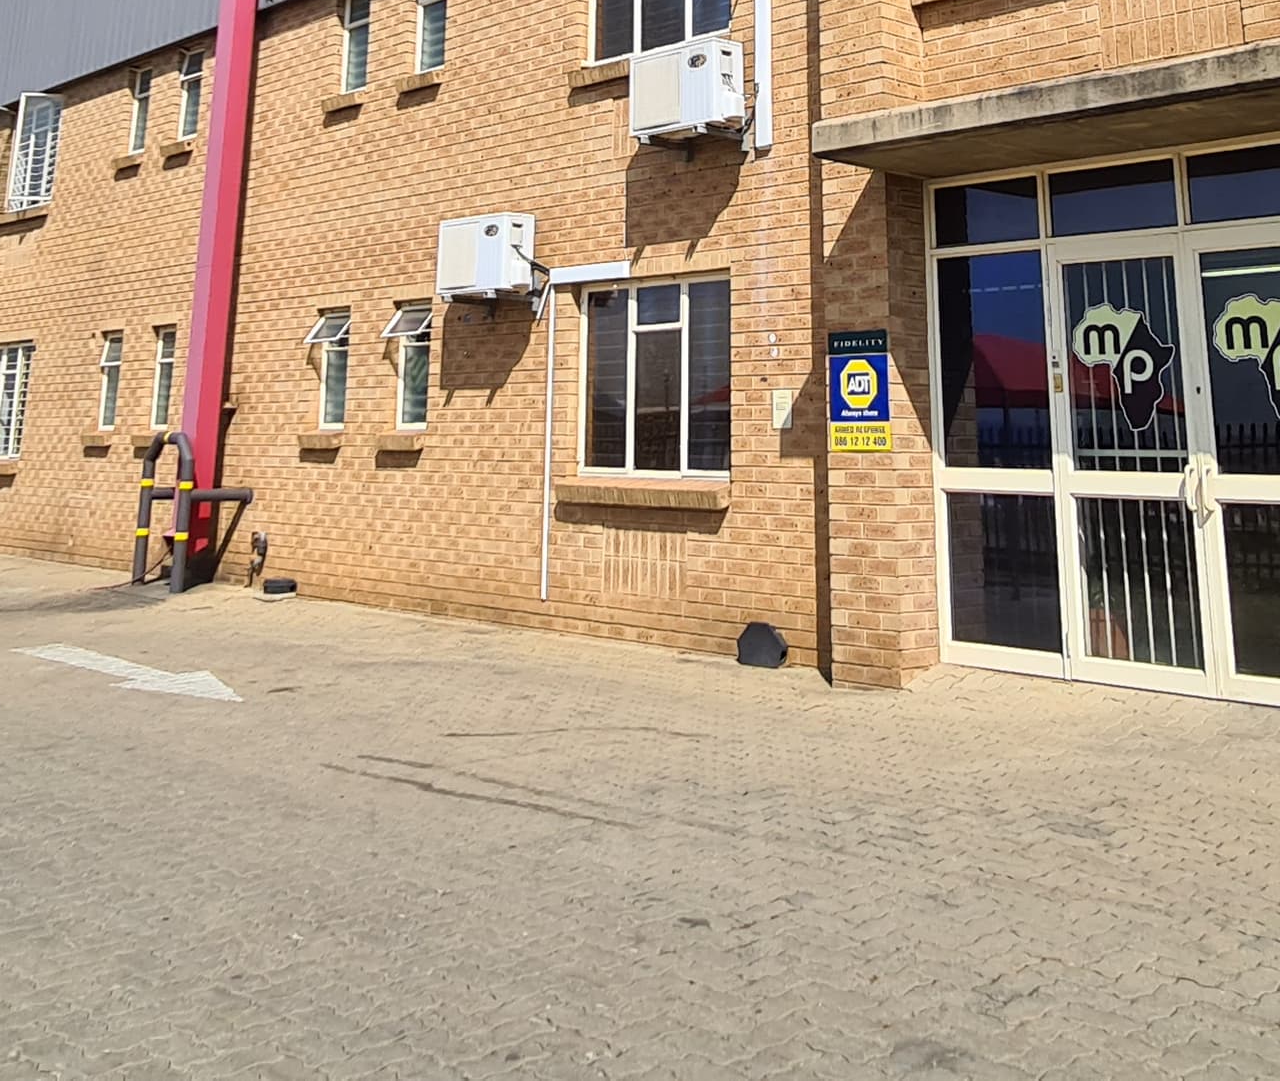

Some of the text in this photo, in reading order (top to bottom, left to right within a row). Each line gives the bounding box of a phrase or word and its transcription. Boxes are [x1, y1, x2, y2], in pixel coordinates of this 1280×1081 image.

[834, 339, 883, 348] FIDELITY
[848, 375, 871, 392] ADT
[841, 410, 862, 418] Always
[850, 436, 859, 446] 12
[862, 436, 871, 446] 12
